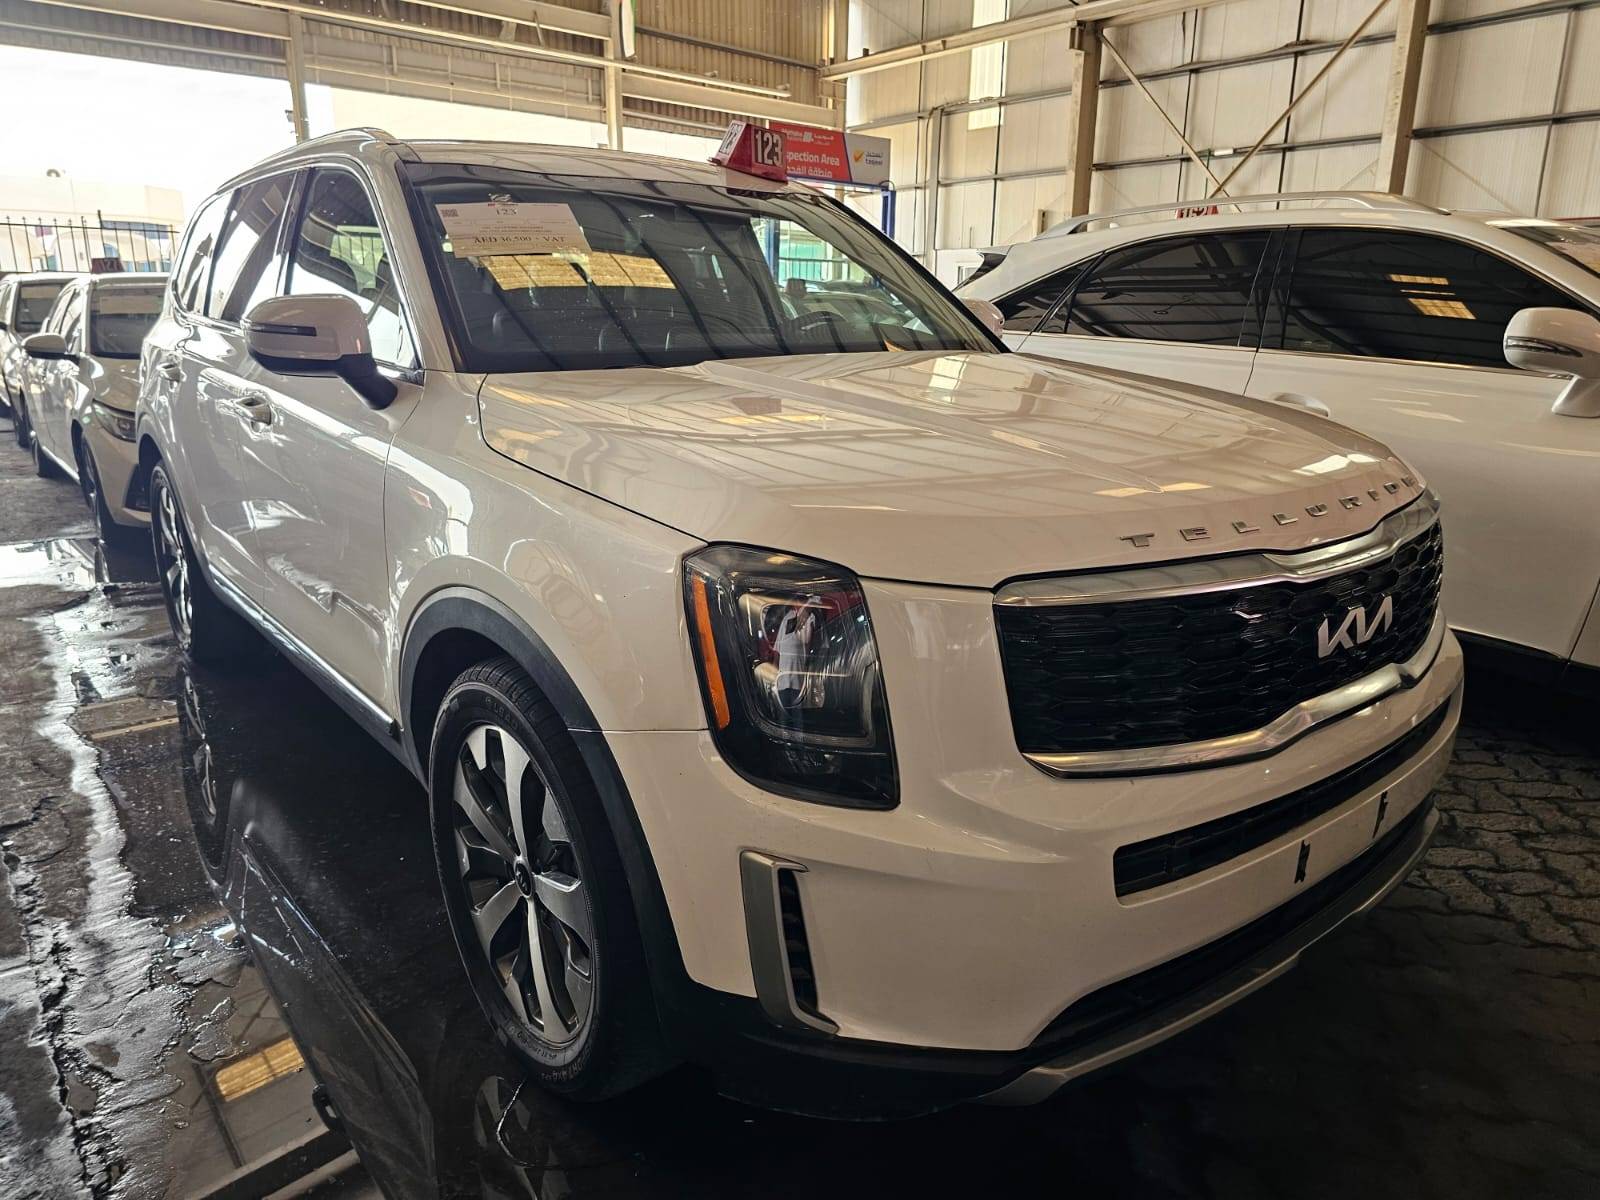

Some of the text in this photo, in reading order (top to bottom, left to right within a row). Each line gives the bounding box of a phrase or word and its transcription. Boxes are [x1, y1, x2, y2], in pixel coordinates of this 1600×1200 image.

[755, 130, 783, 166] 123
[821, 154, 840, 166] Area
[474, 236, 497, 244] AED
[1120, 474, 1418, 548] TELLURIDE
[1317, 593, 1393, 659] KIA
